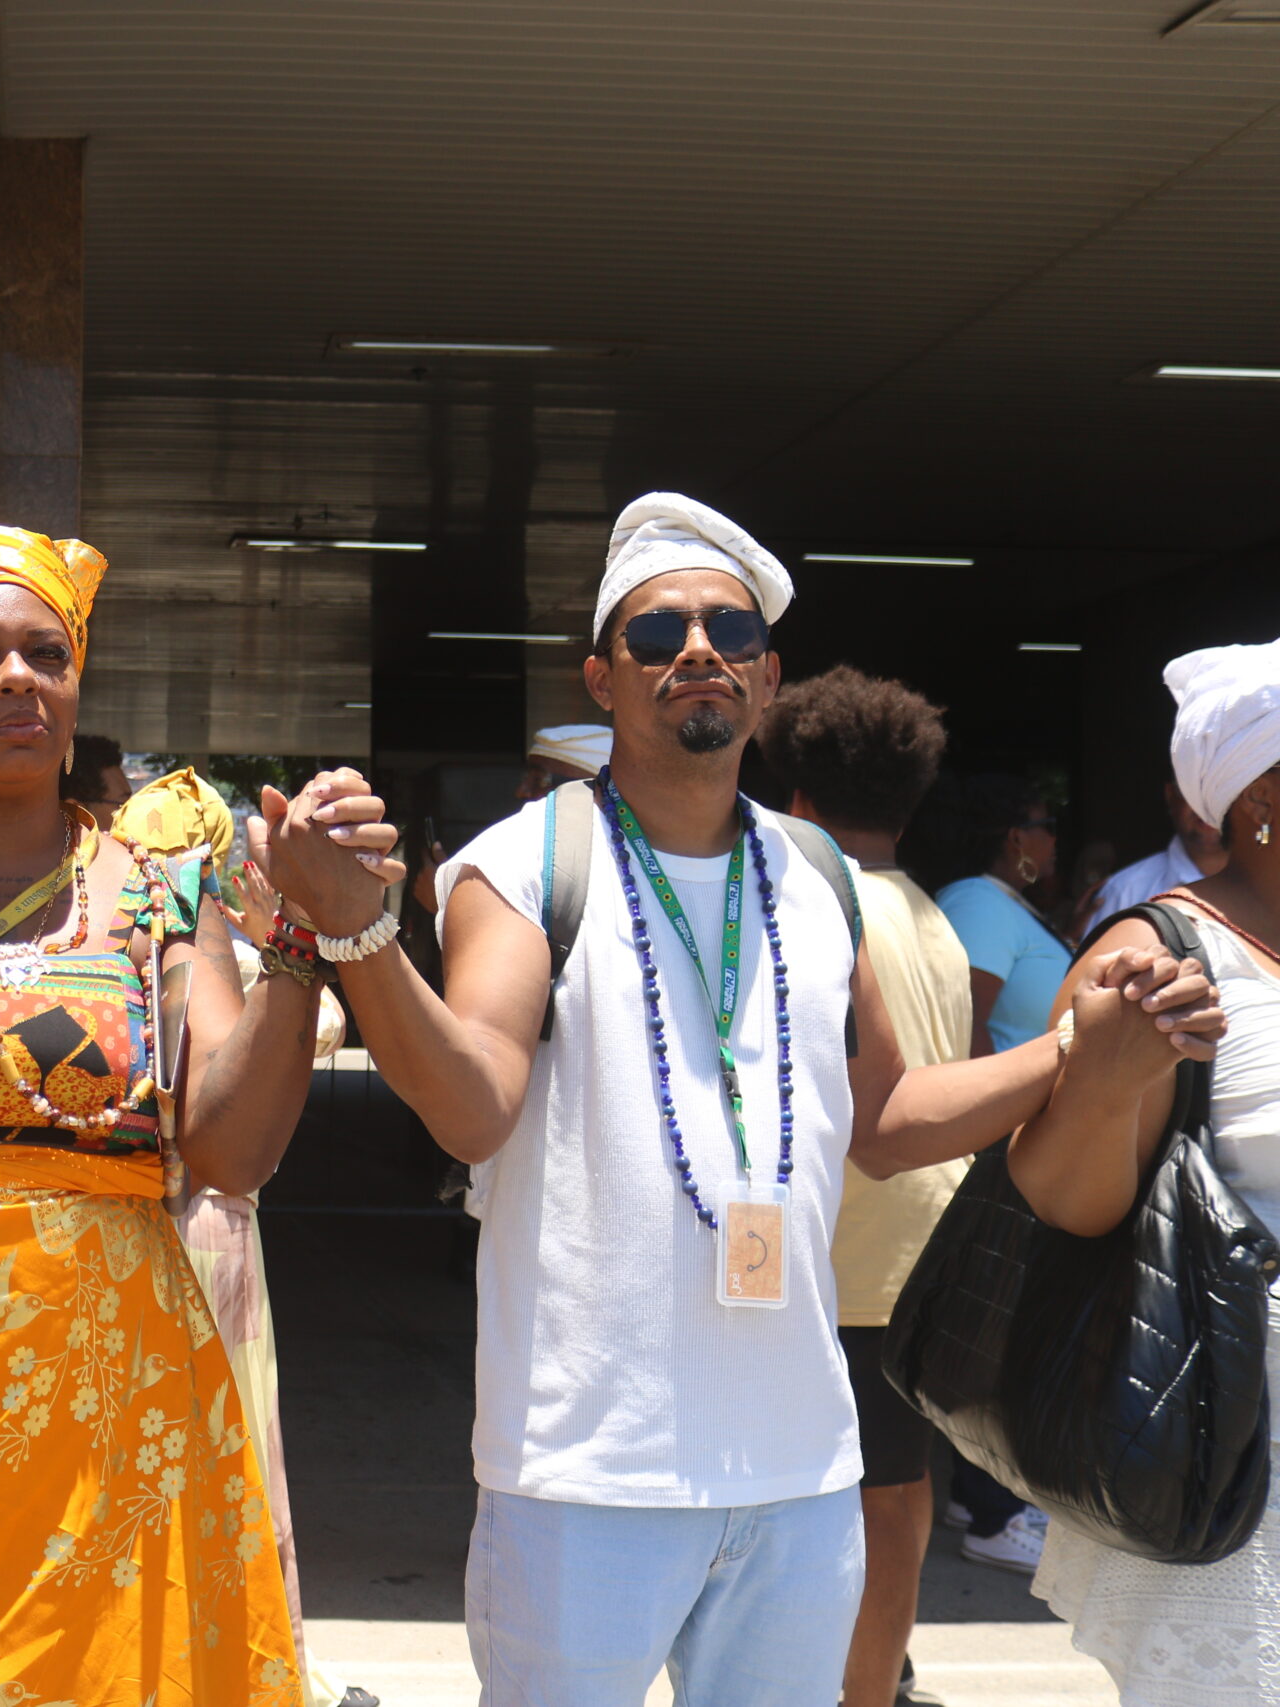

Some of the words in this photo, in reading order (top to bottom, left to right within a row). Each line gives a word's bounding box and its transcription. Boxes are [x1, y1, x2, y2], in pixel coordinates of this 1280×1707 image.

[646, 859, 660, 874] RJ
[730, 884, 739, 898] RJ
[726, 969, 735, 986] RJ
